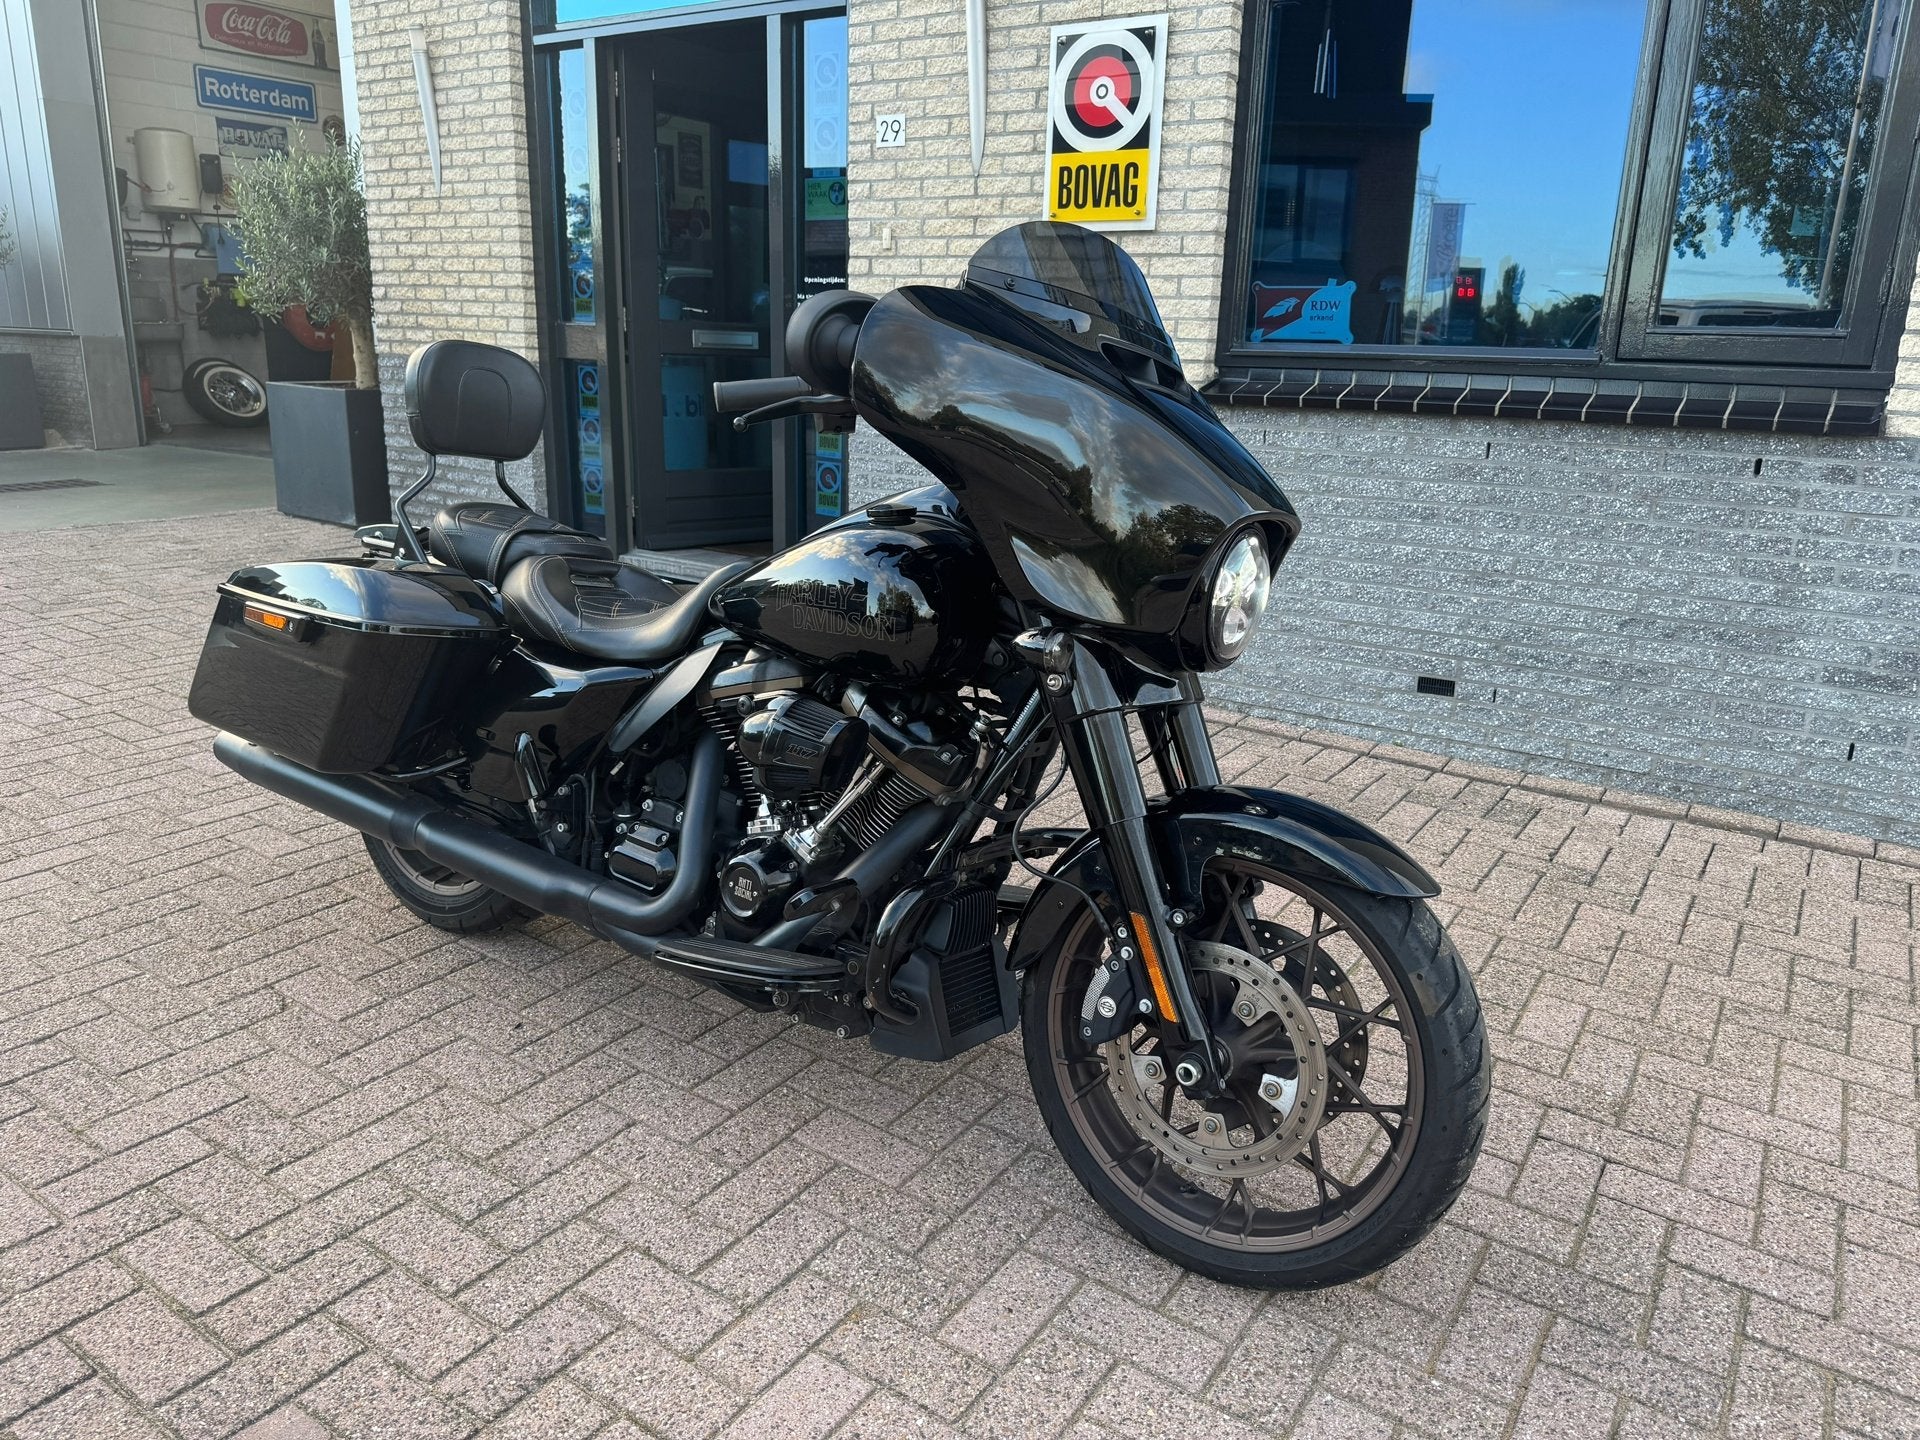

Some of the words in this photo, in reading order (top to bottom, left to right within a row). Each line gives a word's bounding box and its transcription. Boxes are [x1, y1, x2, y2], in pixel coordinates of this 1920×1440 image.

[204, 77, 309, 111] Rotterdam
[880, 119, 902, 142] 29
[1057, 161, 1140, 210] BOVAG
[1310, 300, 1341, 311] RDW
[819, 435, 839, 450] BOVAG
[818, 493, 838, 507] BOVAG
[792, 604, 897, 642] DAVIDSON
